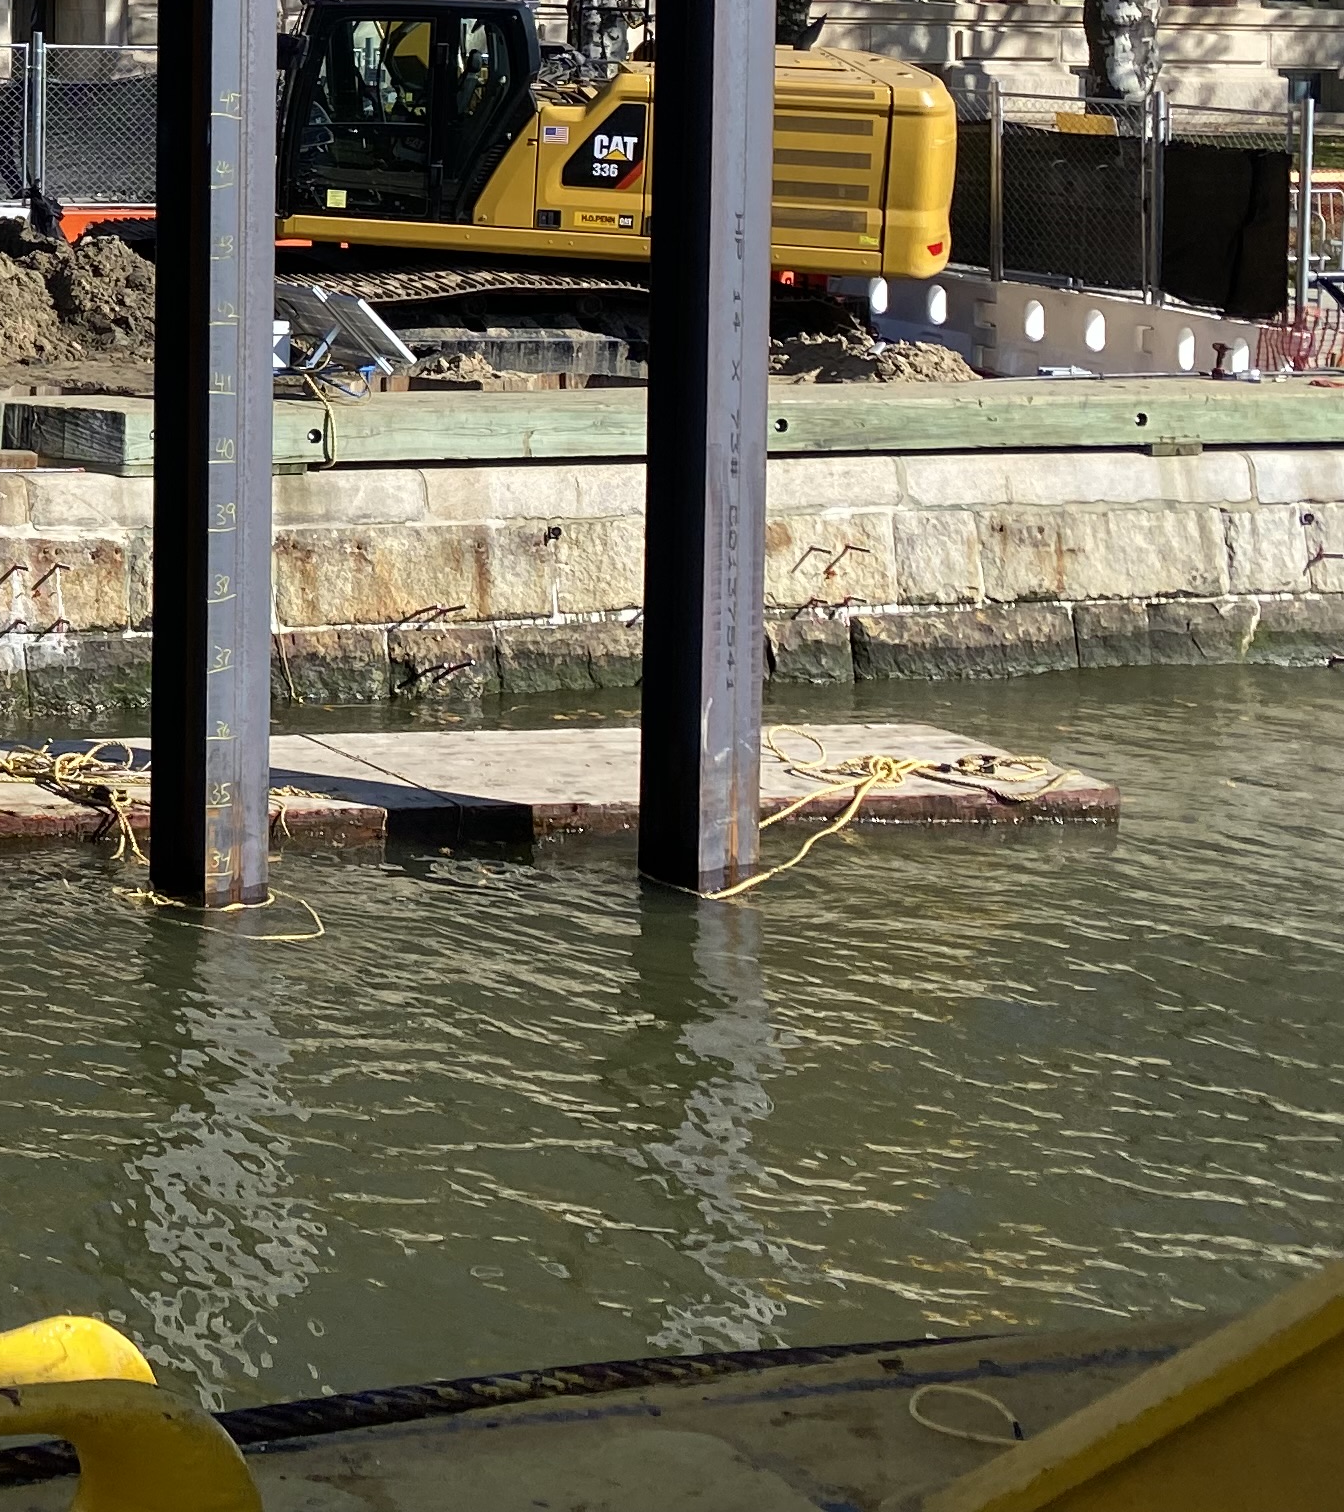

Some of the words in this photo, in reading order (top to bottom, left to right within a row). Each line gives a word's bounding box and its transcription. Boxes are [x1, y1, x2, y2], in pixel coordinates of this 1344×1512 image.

[593, 134, 638, 162] CAT
[592, 163, 619, 177] 336
[215, 372, 231, 392] 41
[216, 438, 234, 459] 40
[216, 502, 236, 525] 39
[214, 645, 232, 668] 37
[212, 782, 232, 805] 35
